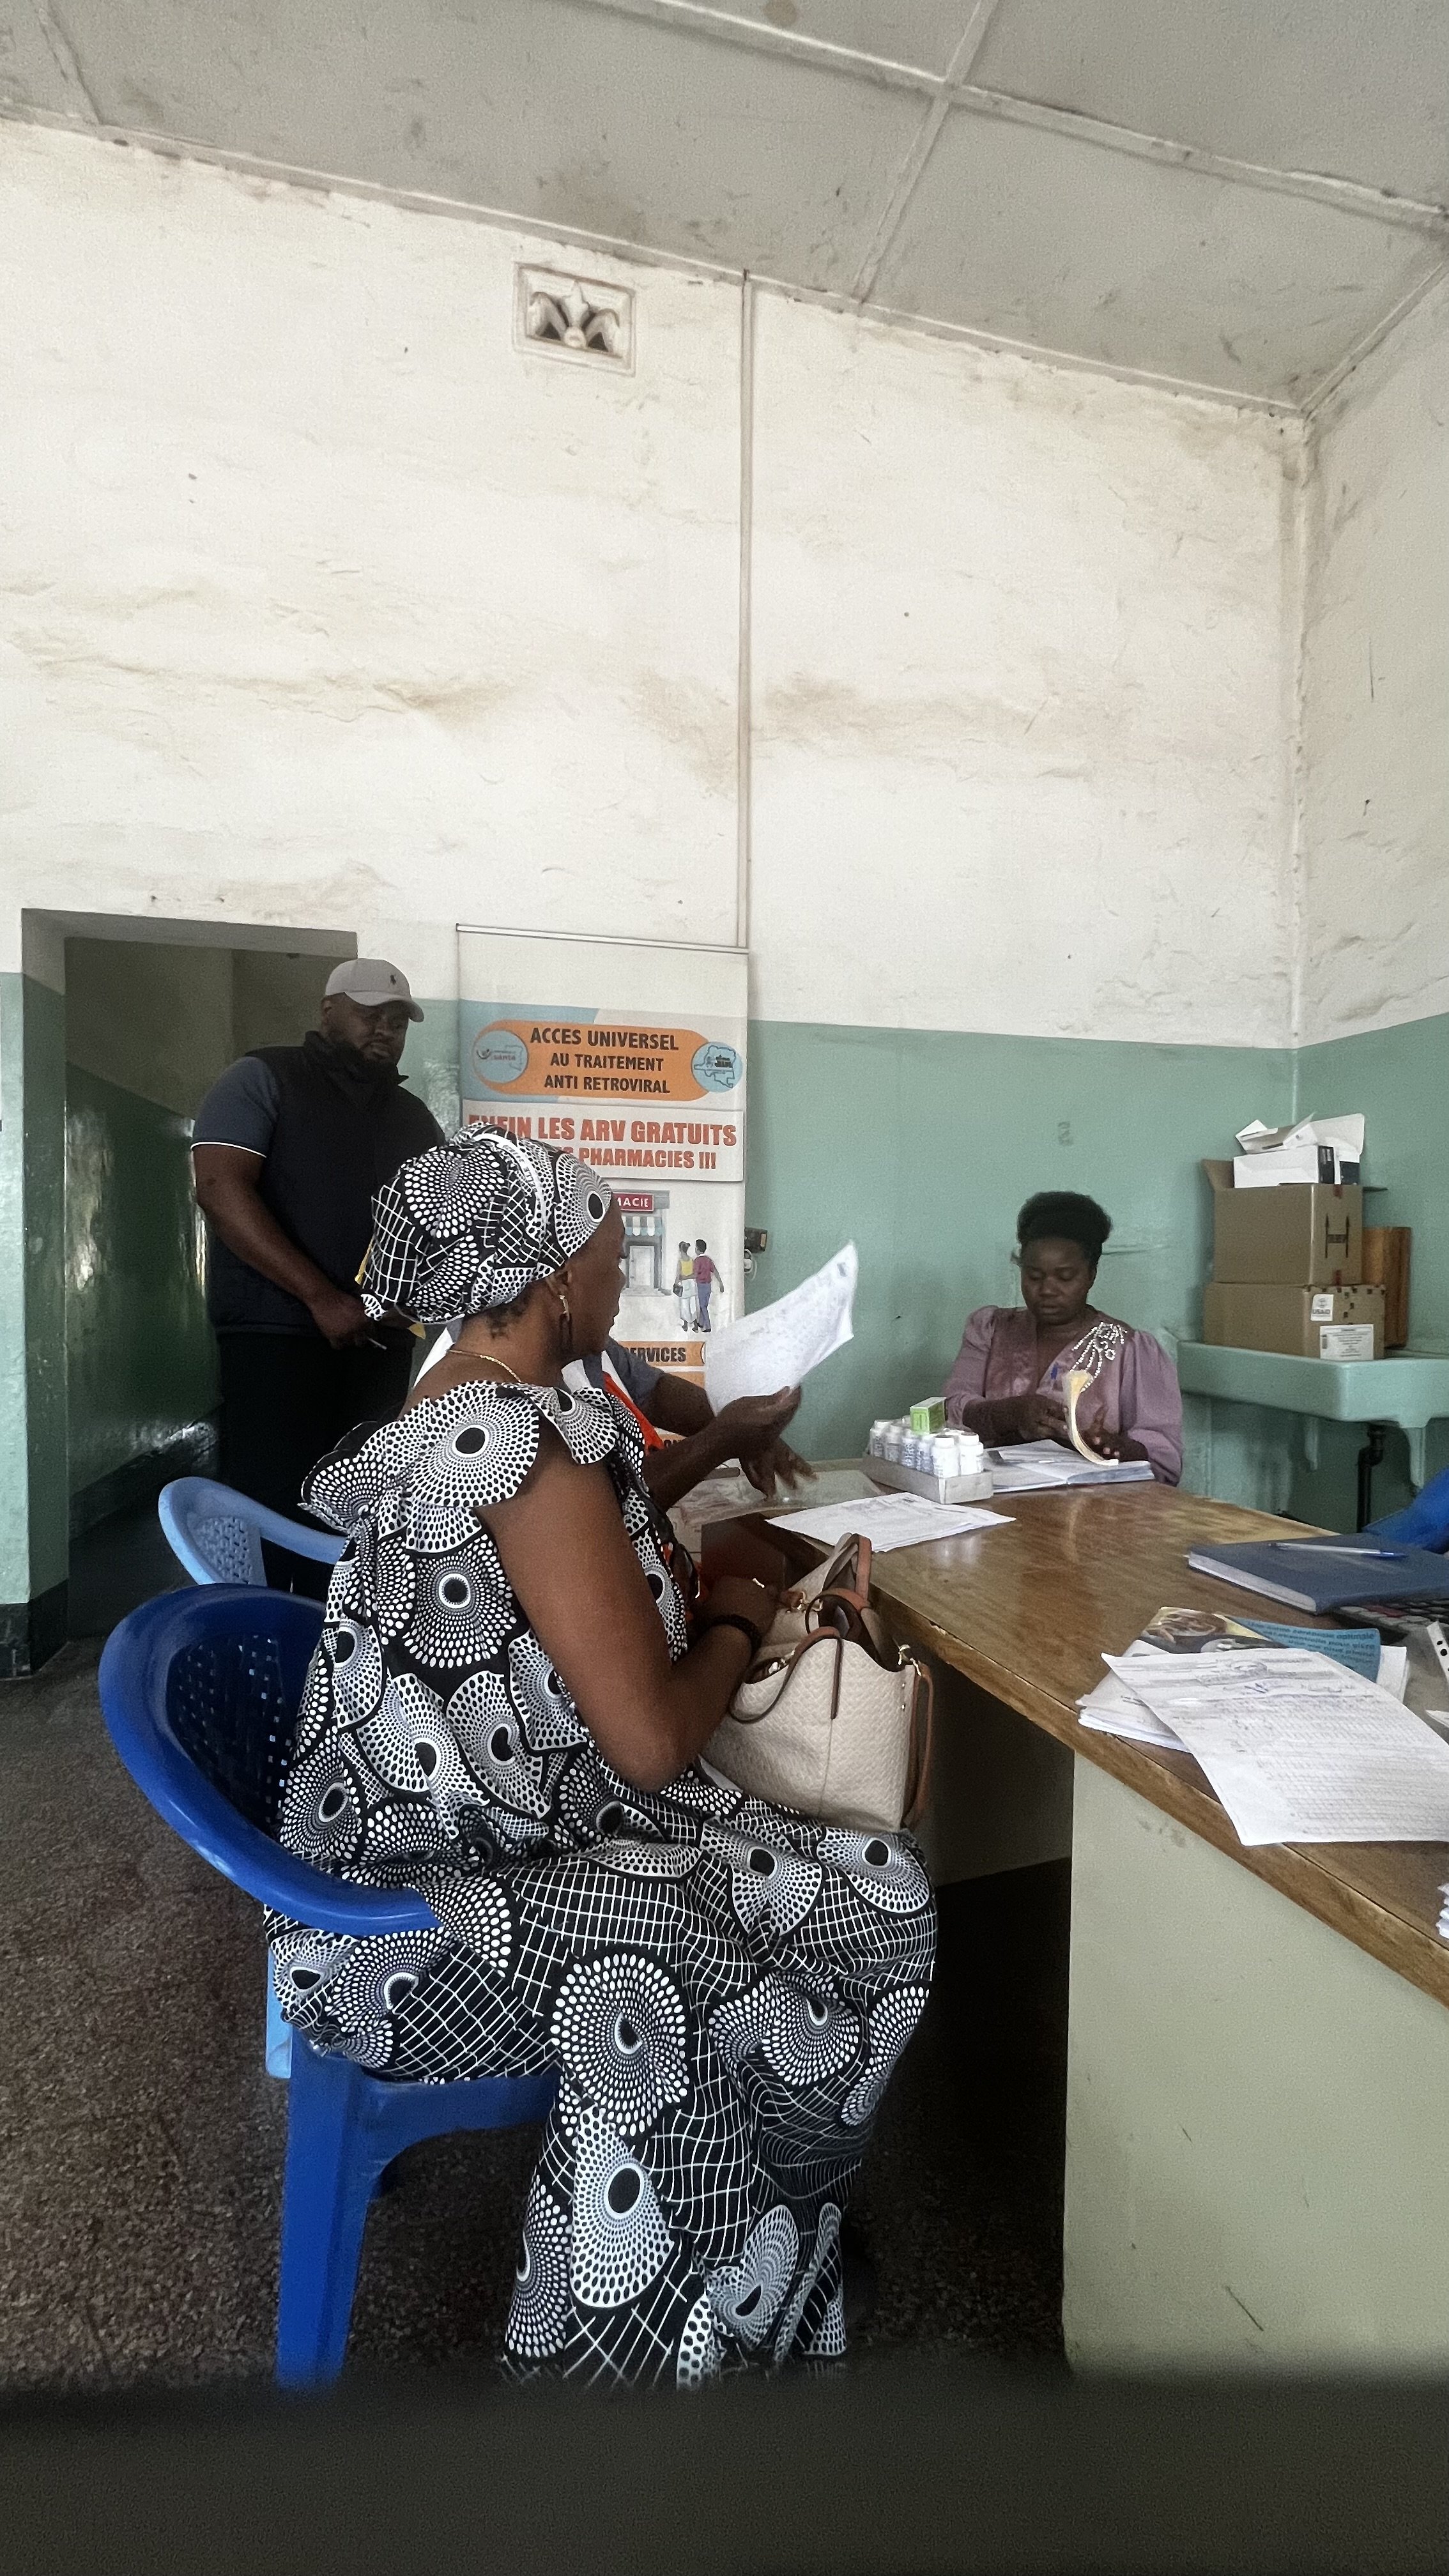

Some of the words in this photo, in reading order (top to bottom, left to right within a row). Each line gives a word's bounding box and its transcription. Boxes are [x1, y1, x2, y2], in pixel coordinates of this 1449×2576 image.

[530, 1027, 581, 1045] ACCES
[588, 1030, 679, 1051] UNIVERSEL
[550, 1052, 569, 1067] AU
[574, 1054, 664, 1071] TRAITEMENT
[544, 1075, 578, 1090] ANTI
[583, 1076, 670, 1094] RETROVIRAL
[538, 1117, 575, 1141] LES
[580, 1119, 627, 1142] ARV
[631, 1121, 737, 1147] GRATUITS
[579, 1147, 694, 1168] PHARMACIES
[625, 1347, 687, 1362] RVICES
